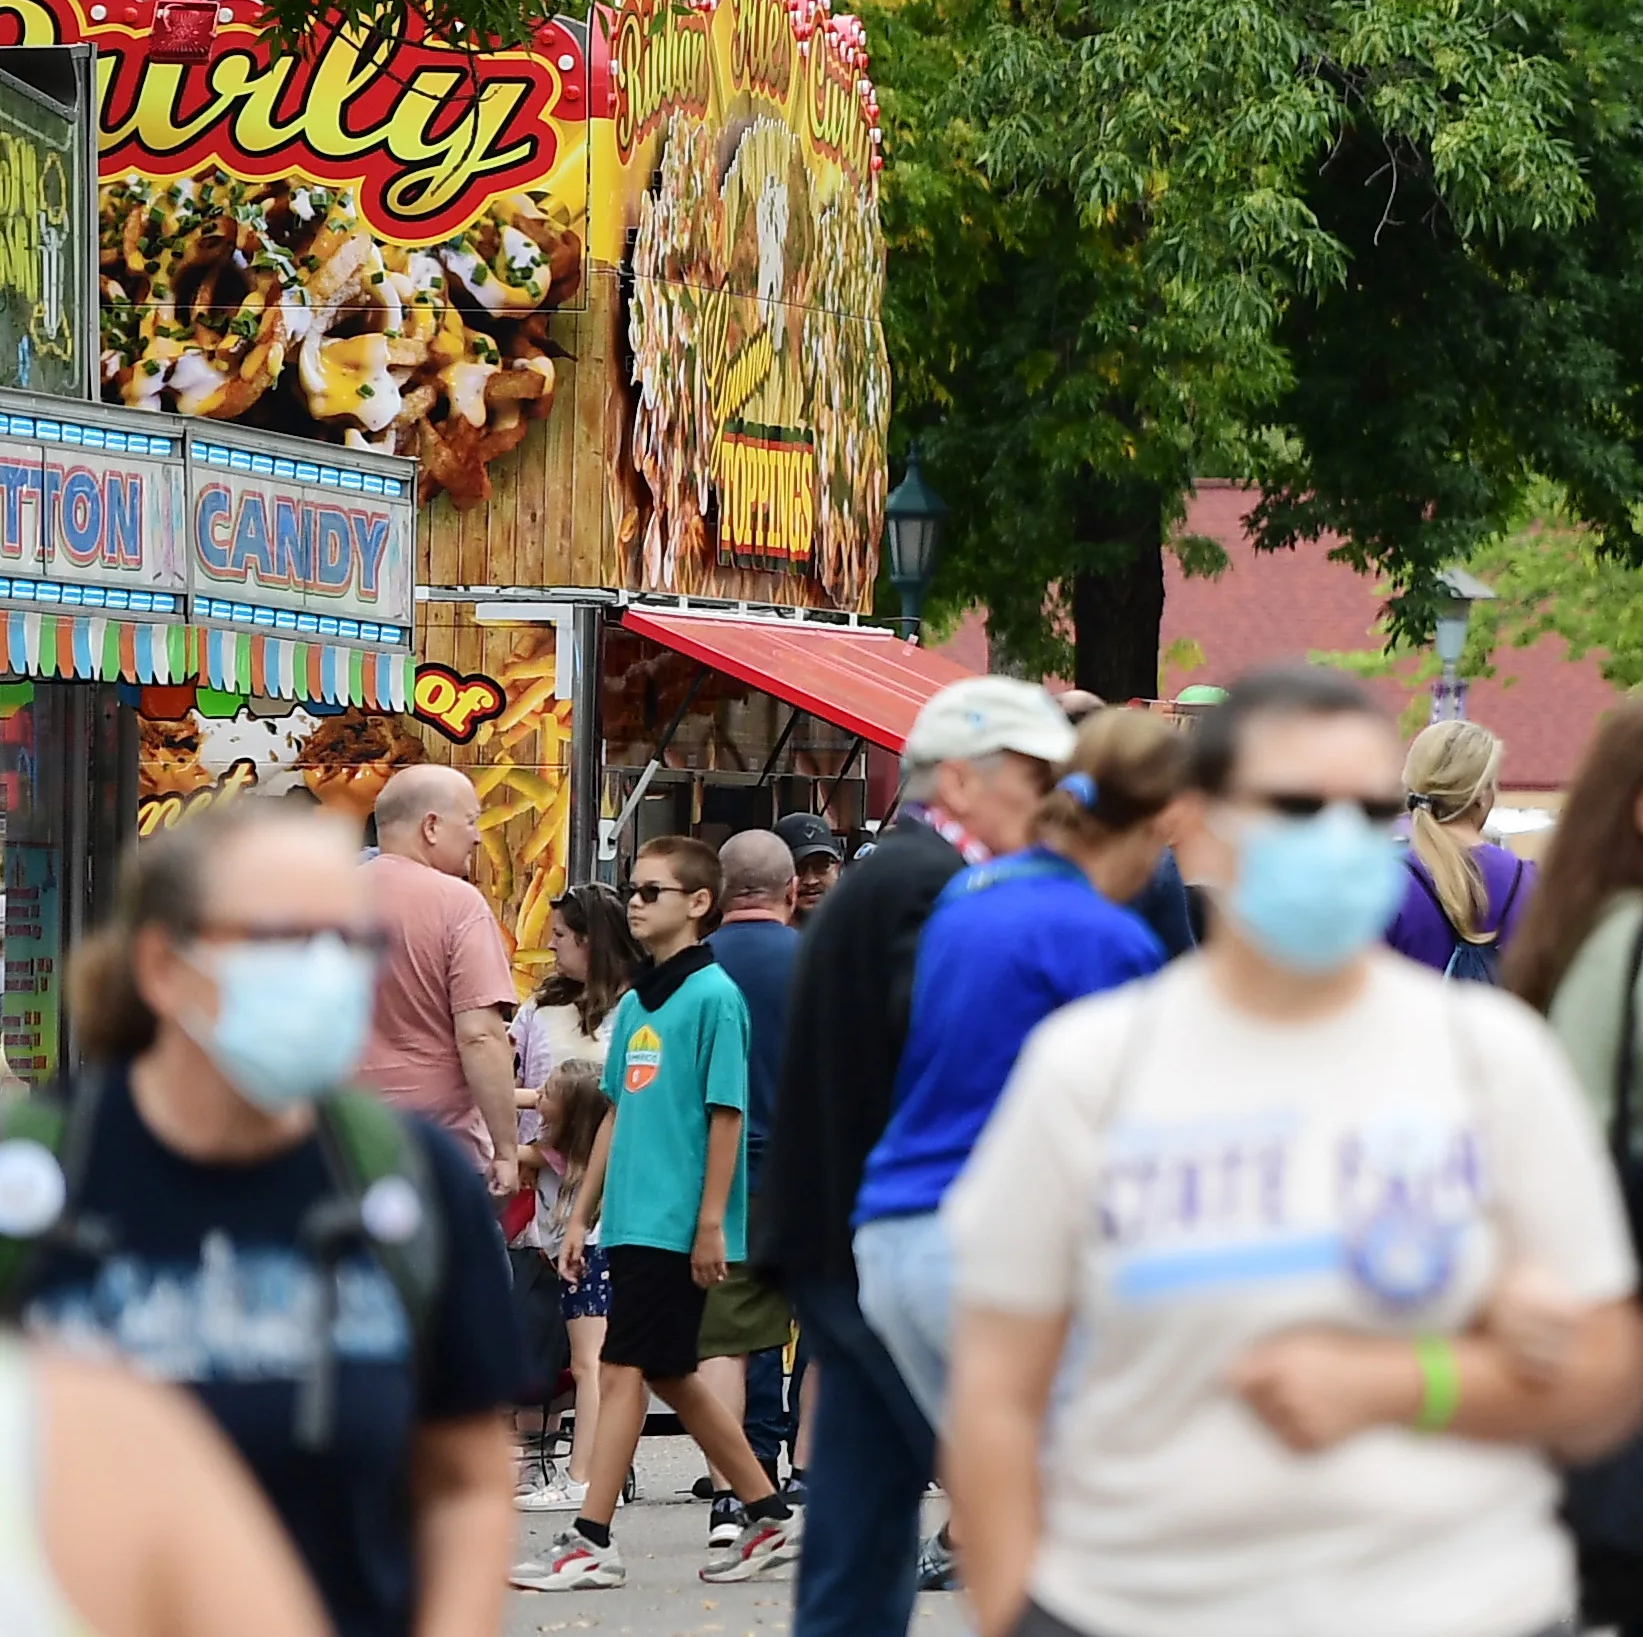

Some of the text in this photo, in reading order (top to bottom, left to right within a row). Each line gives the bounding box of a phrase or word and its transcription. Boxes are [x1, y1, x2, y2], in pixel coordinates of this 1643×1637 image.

[195, 483, 390, 602] CANDY
[721, 440, 814, 555] TOPPINGS
[414, 674, 494, 732] of
